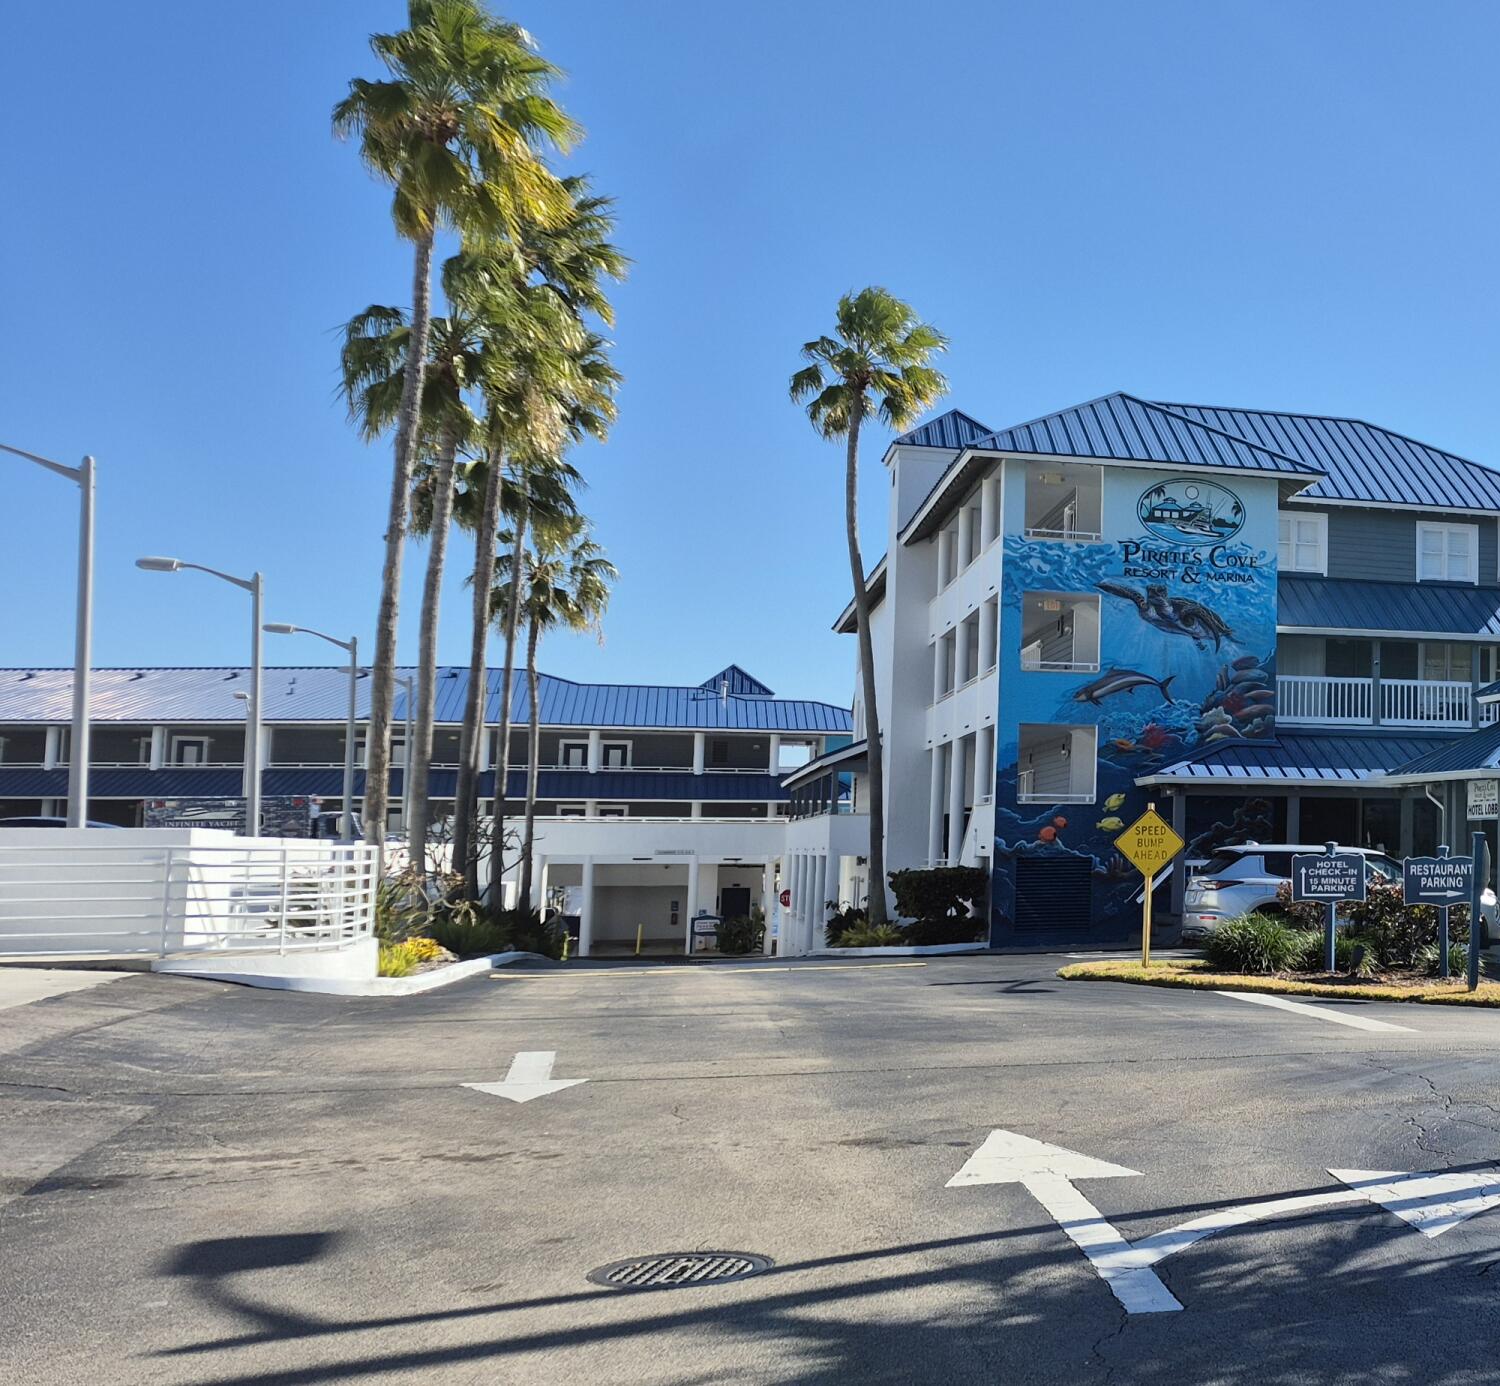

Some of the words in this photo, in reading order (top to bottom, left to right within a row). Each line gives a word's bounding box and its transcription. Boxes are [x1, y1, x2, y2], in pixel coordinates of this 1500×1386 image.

[1209, 545, 1262, 569] COVE
[1123, 567, 1178, 580] RESORT
[1181, 566, 1201, 584] &
[1206, 572, 1255, 583] MARINA
[1468, 804, 1484, 816] HOTEL
[1485, 803, 1499, 815] LOBB
[1135, 826, 1166, 836] SPEED
[1137, 838, 1164, 848] BUMP
[1133, 850, 1168, 860] AHEAD
[1308, 868, 1358, 876] CHECK-IN
[1410, 864, 1473, 876] RESTAURANT
[1309, 877, 1319, 885] 15
[1321, 877, 1357, 885] MINUTE
[1421, 876, 1463, 888] PARKING
[1311, 884, 1355, 892] PARKING
